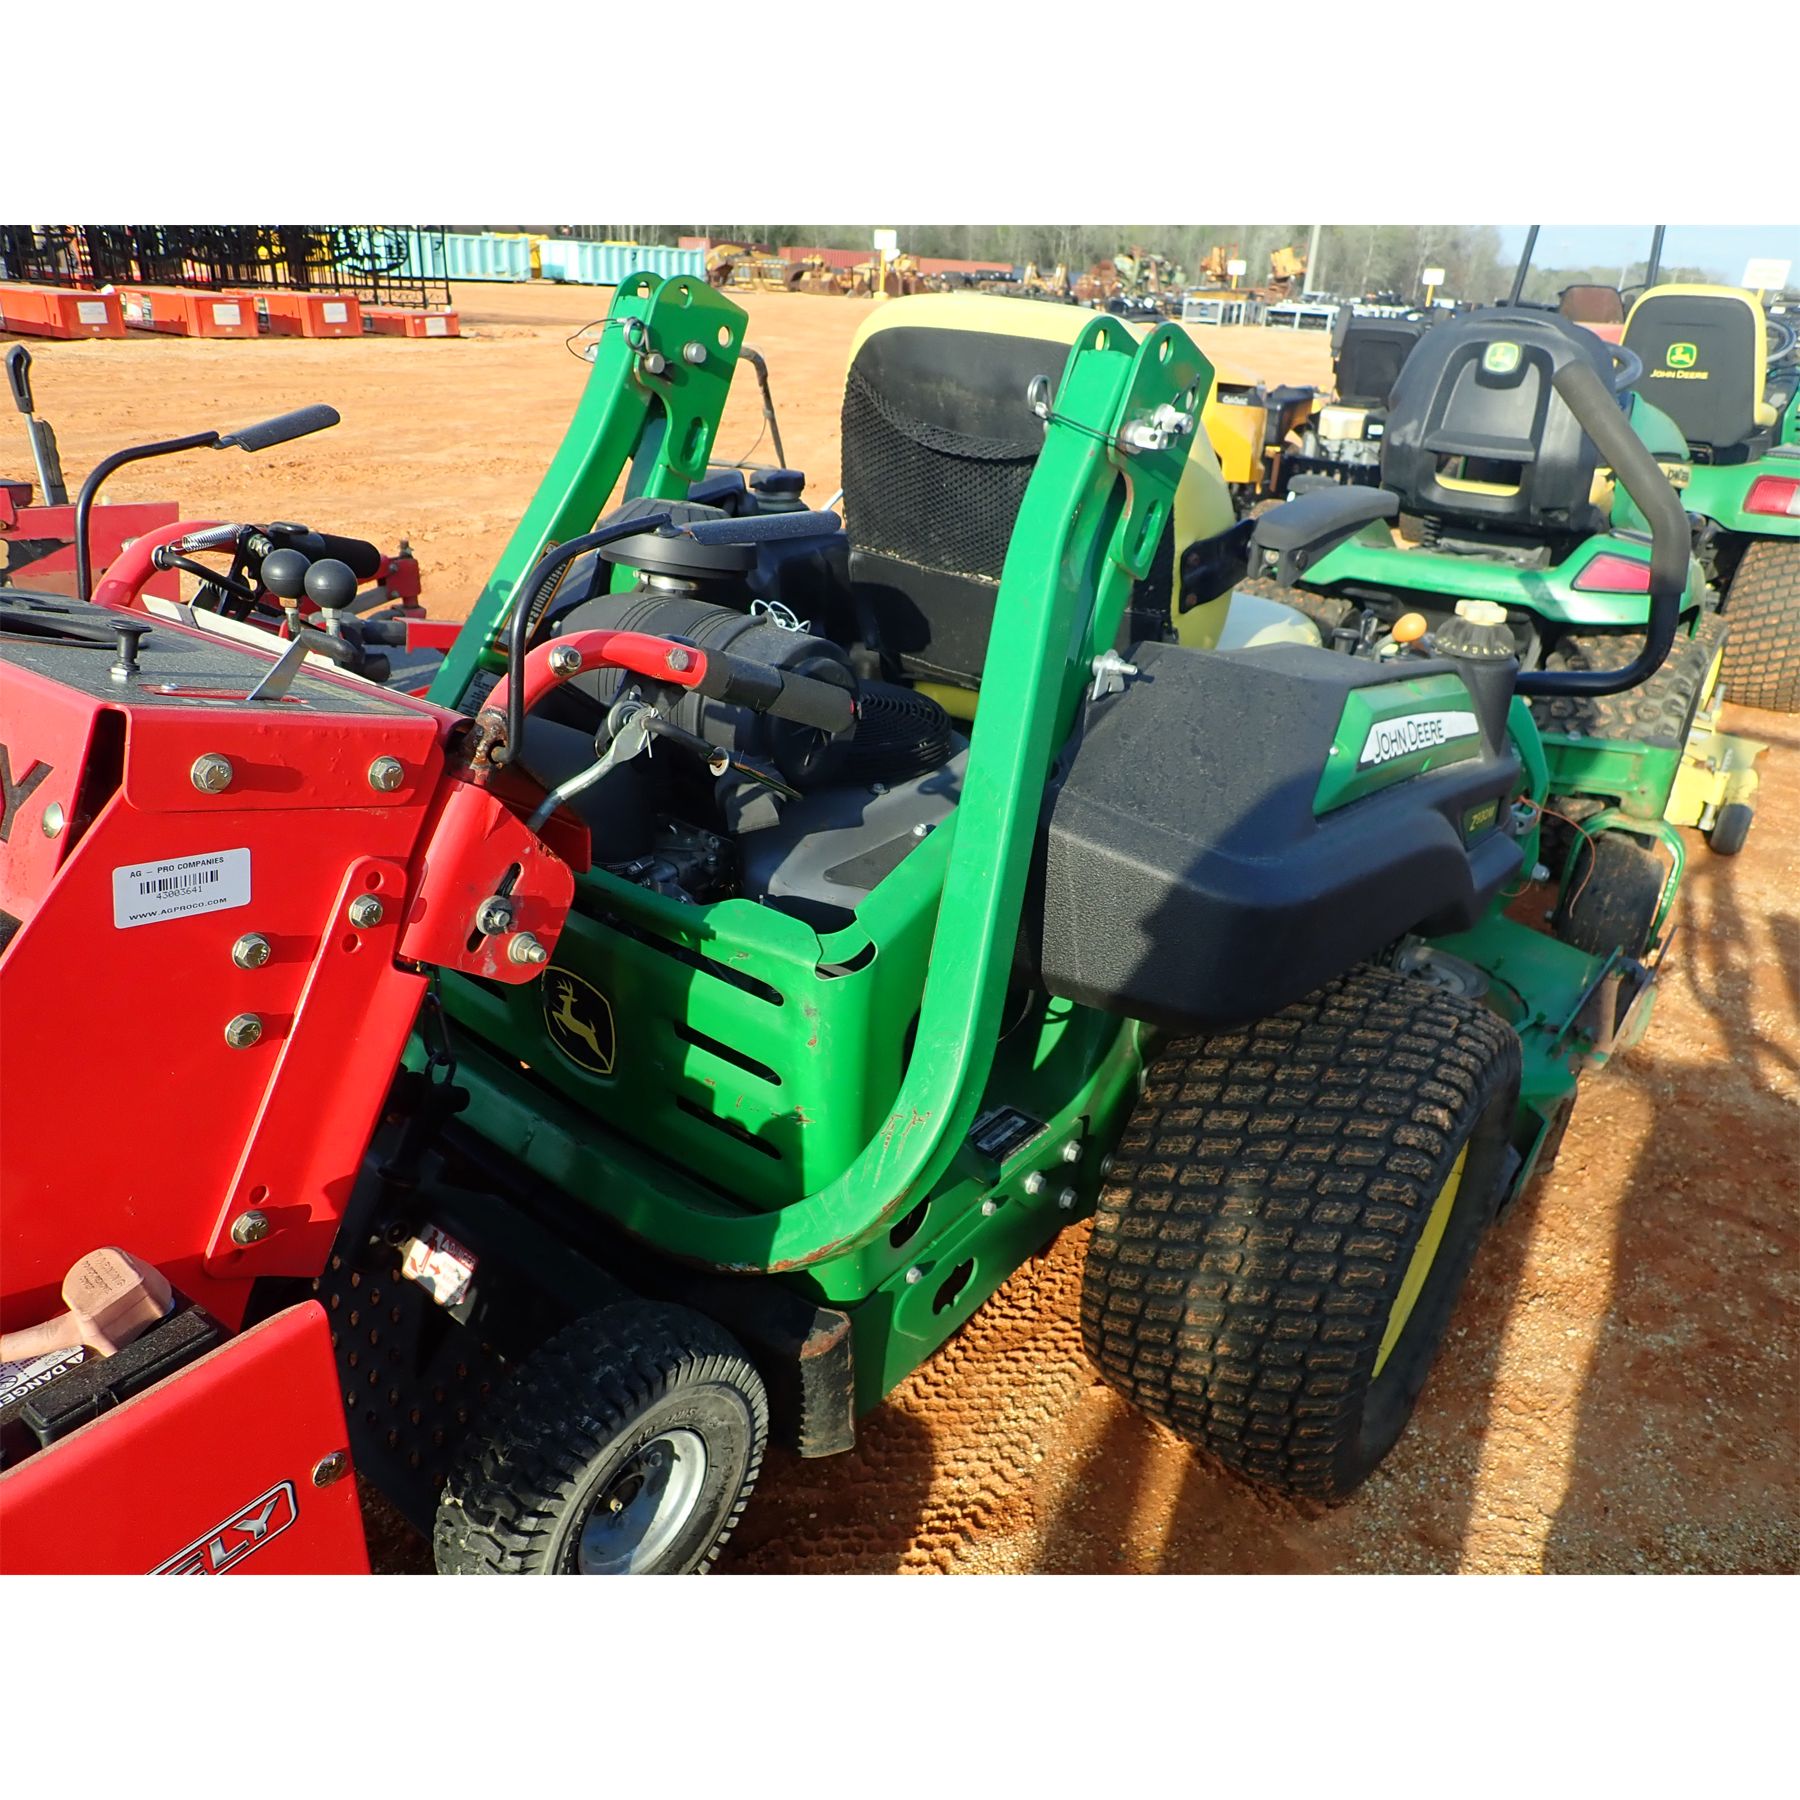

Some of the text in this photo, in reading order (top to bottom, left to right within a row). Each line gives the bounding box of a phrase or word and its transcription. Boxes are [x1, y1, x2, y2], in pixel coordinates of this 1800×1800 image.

[1375, 719, 1444, 758] JOHN DEERE
[130, 870, 142, 878] AG
[157, 865, 175, 873] PRO
[177, 857, 224, 870] COMPANIES
[156, 885, 203, 900] 43003641
[129, 898, 227, 920] WWW.AGPROCO.COM
[0, 1364, 66, 1408] DANGE
